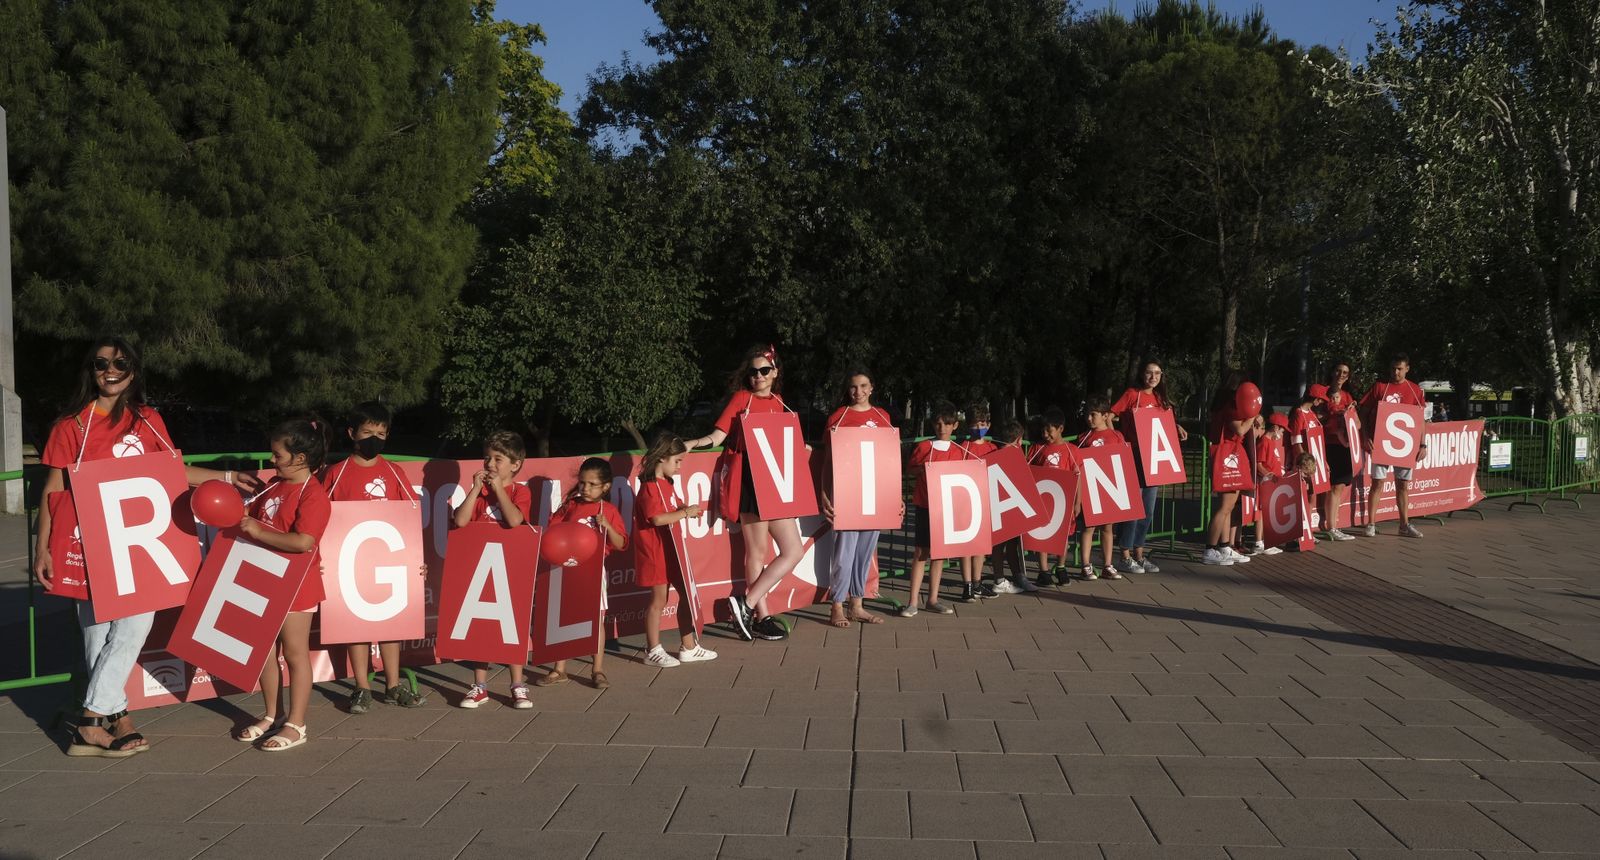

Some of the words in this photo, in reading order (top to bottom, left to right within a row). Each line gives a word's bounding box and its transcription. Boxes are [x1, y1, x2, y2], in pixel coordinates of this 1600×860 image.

[752, 426, 794, 503] V
[1150, 417, 1181, 475] A
[1309, 434, 1327, 485] N
[1349, 417, 1360, 464] O
[1382, 411, 1415, 458] S
[1415, 424, 1478, 470] ONACIÓN
[860, 441, 876, 515] I
[940, 473, 983, 545] D
[987, 463, 1037, 532] A
[1082, 454, 1131, 515] N
[1269, 484, 1297, 534] G
[1383, 480, 1396, 493] IDA
[1414, 478, 1440, 491] órganos
[98, 476, 190, 596] R
[191, 536, 291, 666] E
[338, 520, 408, 622] G
[450, 542, 520, 645] A
[545, 565, 593, 645] L
